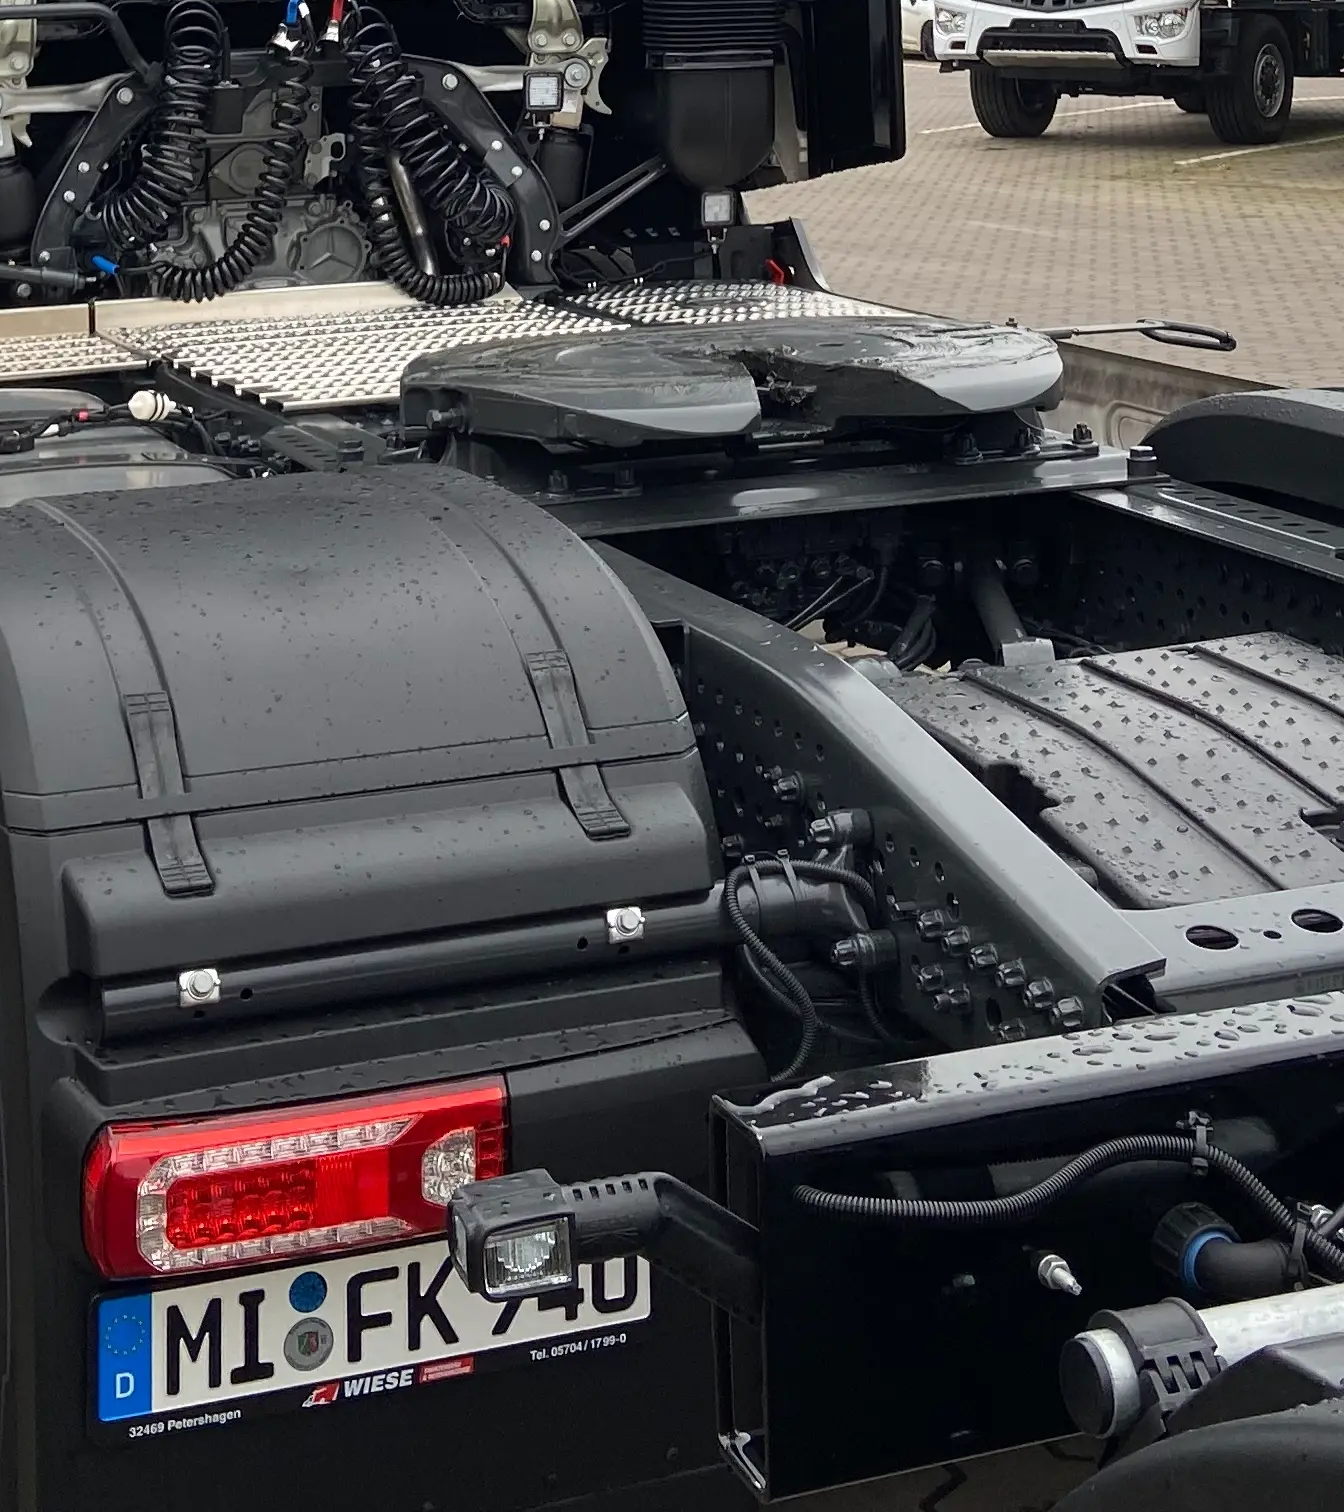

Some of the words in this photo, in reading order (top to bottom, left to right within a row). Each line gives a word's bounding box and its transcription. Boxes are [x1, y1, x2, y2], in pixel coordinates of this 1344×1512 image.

[166, 1289, 274, 1396] MI
[346, 1256, 459, 1364] FK
[530, 1348, 549, 1361] Tel.
[115, 1373, 135, 1399] D
[343, 1368, 414, 1398] WIESE
[129, 1420, 165, 1439] 32469
[167, 1409, 242, 1432] Petershagen
